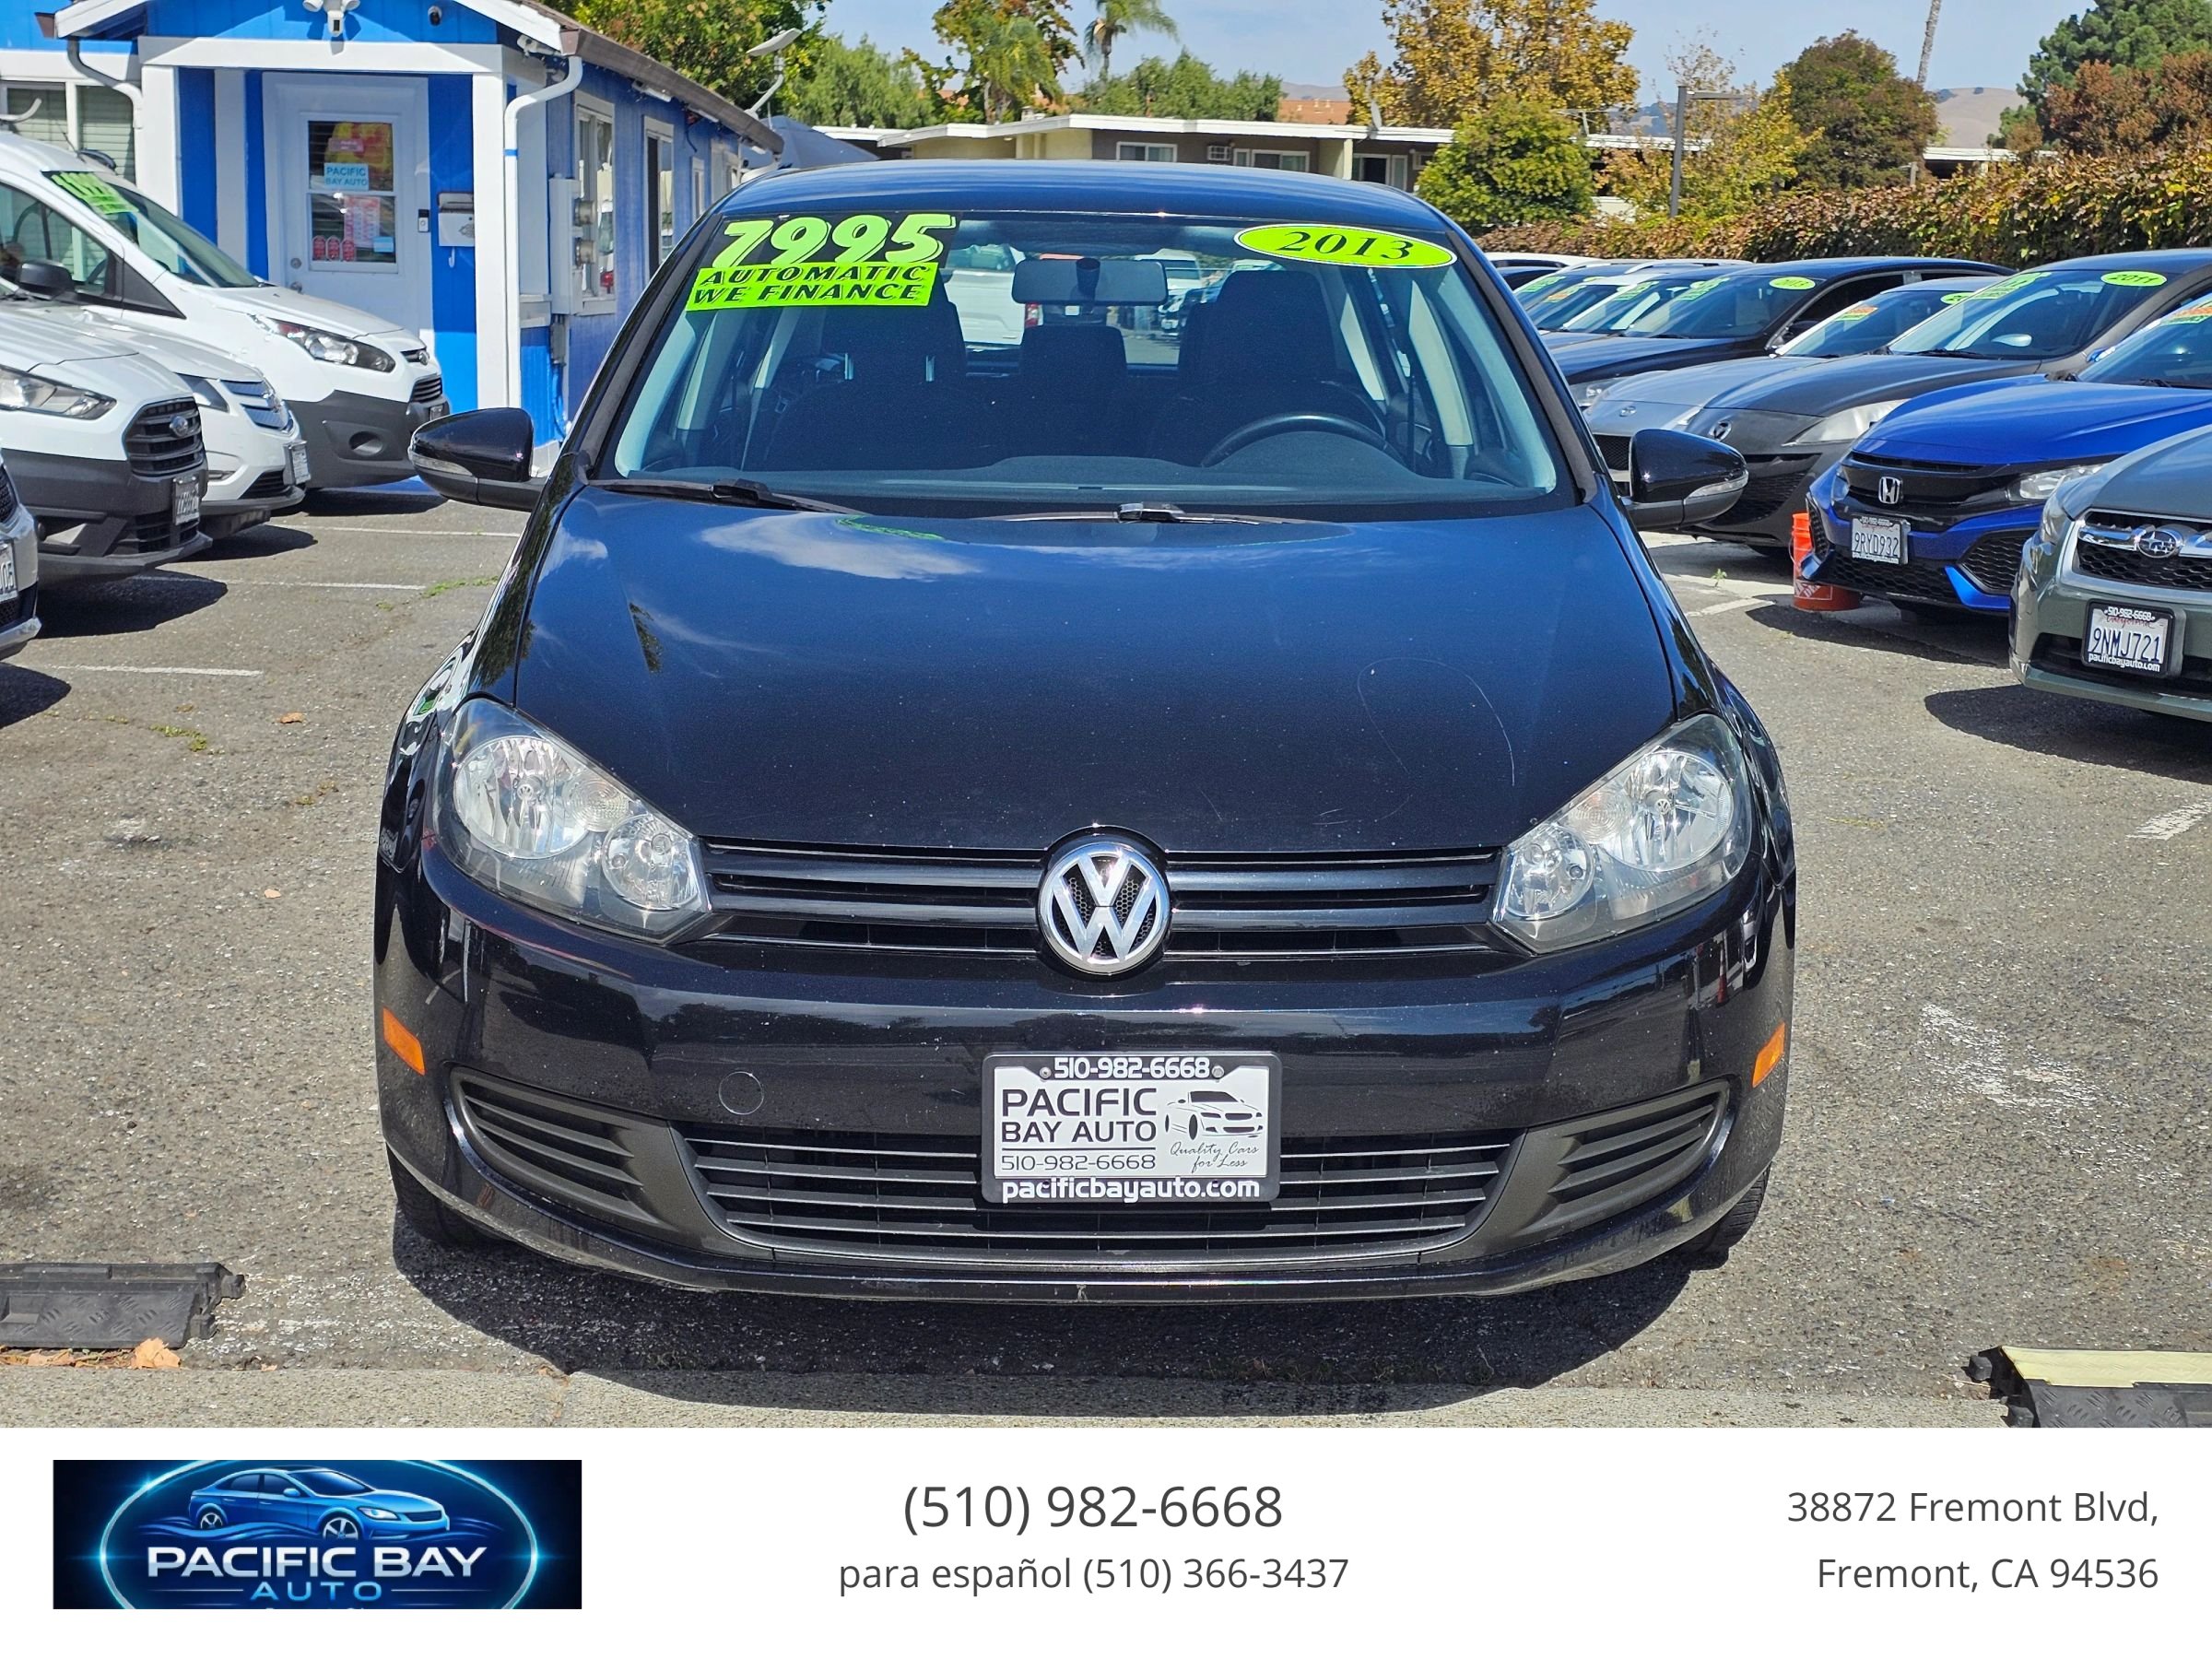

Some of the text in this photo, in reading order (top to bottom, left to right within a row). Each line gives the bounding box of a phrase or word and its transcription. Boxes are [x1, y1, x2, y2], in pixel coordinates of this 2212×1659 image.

[325, 177, 368, 186] BAY AUTO
[326, 167, 366, 177] PACIFIC
[712, 214, 956, 269] 7995
[1277, 231, 1413, 260] 2013
[700, 265, 928, 286] AUTOMATIC
[2107, 274, 2159, 284] 2011
[694, 284, 923, 304] WE FINANCE
[1854, 532, 1899, 559] 9RYD932
[2093, 628, 2159, 664] 9NMJ721
[2088, 653, 2160, 672] pacificbayauto.com
[1054, 1057, 1209, 1079] 510-982-6668
[1002, 1088, 1157, 1117] PACIFIC
[1002, 1121, 1157, 1143] BAY AUTO
[1170, 1141, 1260, 1161] Quality Cars
[1001, 1154, 1156, 1171] 510-982-6668
[1191, 1153, 1248, 1173] for Less
[1002, 1176, 1260, 1204] pacificbayauto.com
